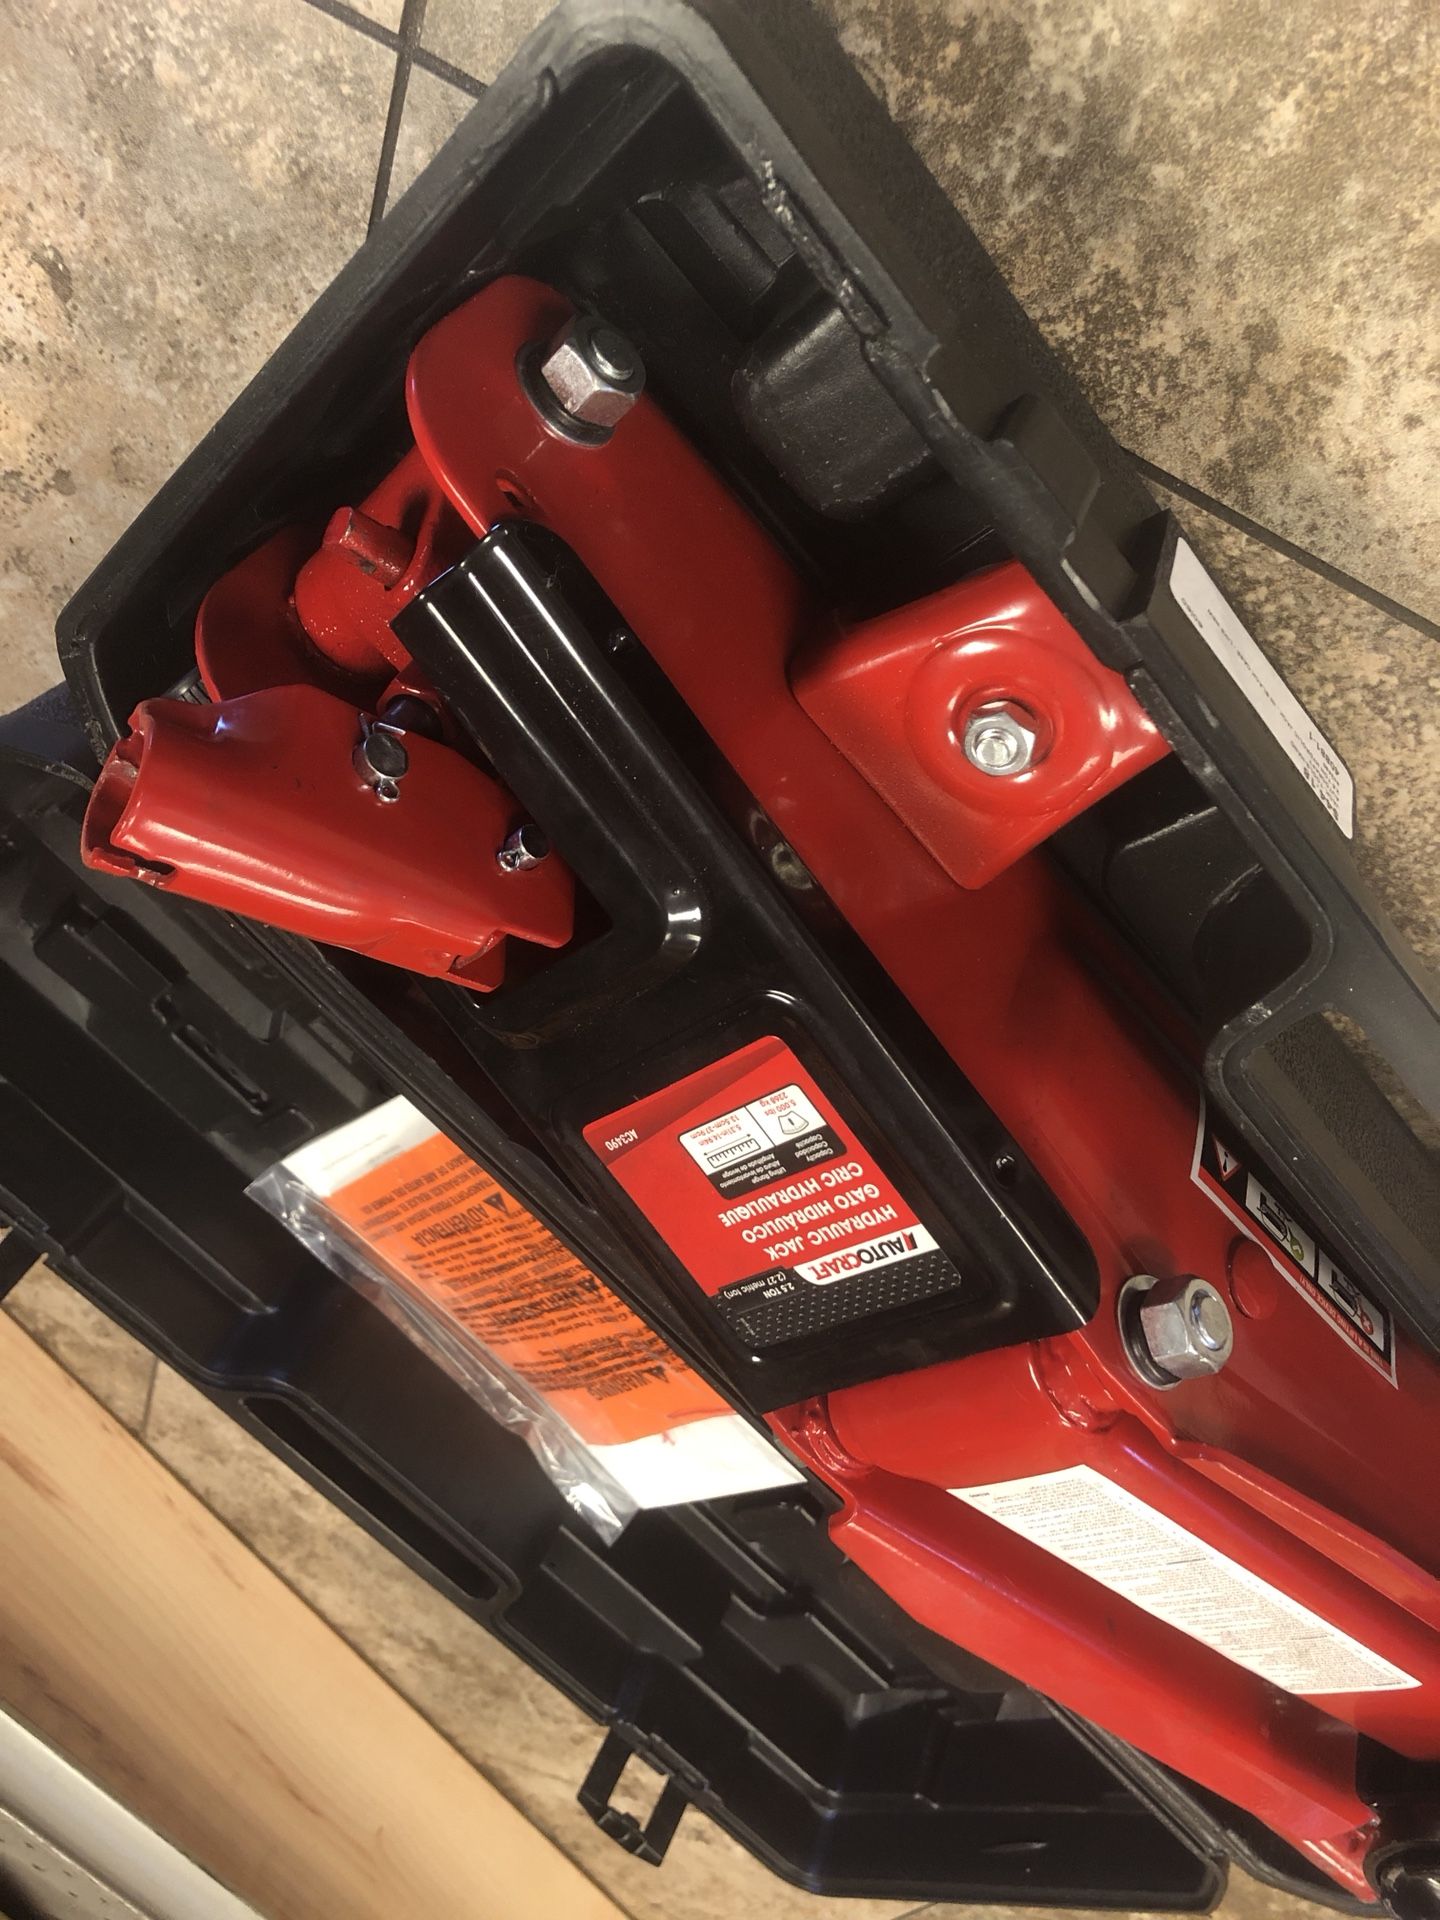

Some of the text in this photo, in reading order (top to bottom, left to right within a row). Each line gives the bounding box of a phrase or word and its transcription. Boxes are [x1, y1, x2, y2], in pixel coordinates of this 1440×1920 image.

[758, 1091, 788, 1108] 2268 kg
[603, 1128, 639, 1150] AC3490
[793, 1139, 828, 1158] Capacidad
[745, 1151, 775, 1168] Amplitude
[804, 1145, 833, 1163] Capacity
[750, 1165, 786, 1184] Lifting Range
[754, 1166, 764, 1174] de
[762, 1159, 781, 1171] Altura
[716, 1160, 865, 1227] CRIC HYDRAULIQUE
[739, 1181, 881, 1245] GATO HIDRÁULICO
[414, 1204, 490, 1248] ADVERTENCIA
[762, 1203, 897, 1261] HYDRAULIC JACK
[808, 1235, 908, 1280] AUTOCRAFT
[722, 1270, 786, 1300] (2.27 metric ton)
[762, 1281, 794, 1299] 2.5 TON
[583, 1370, 653, 1402] WARNING
